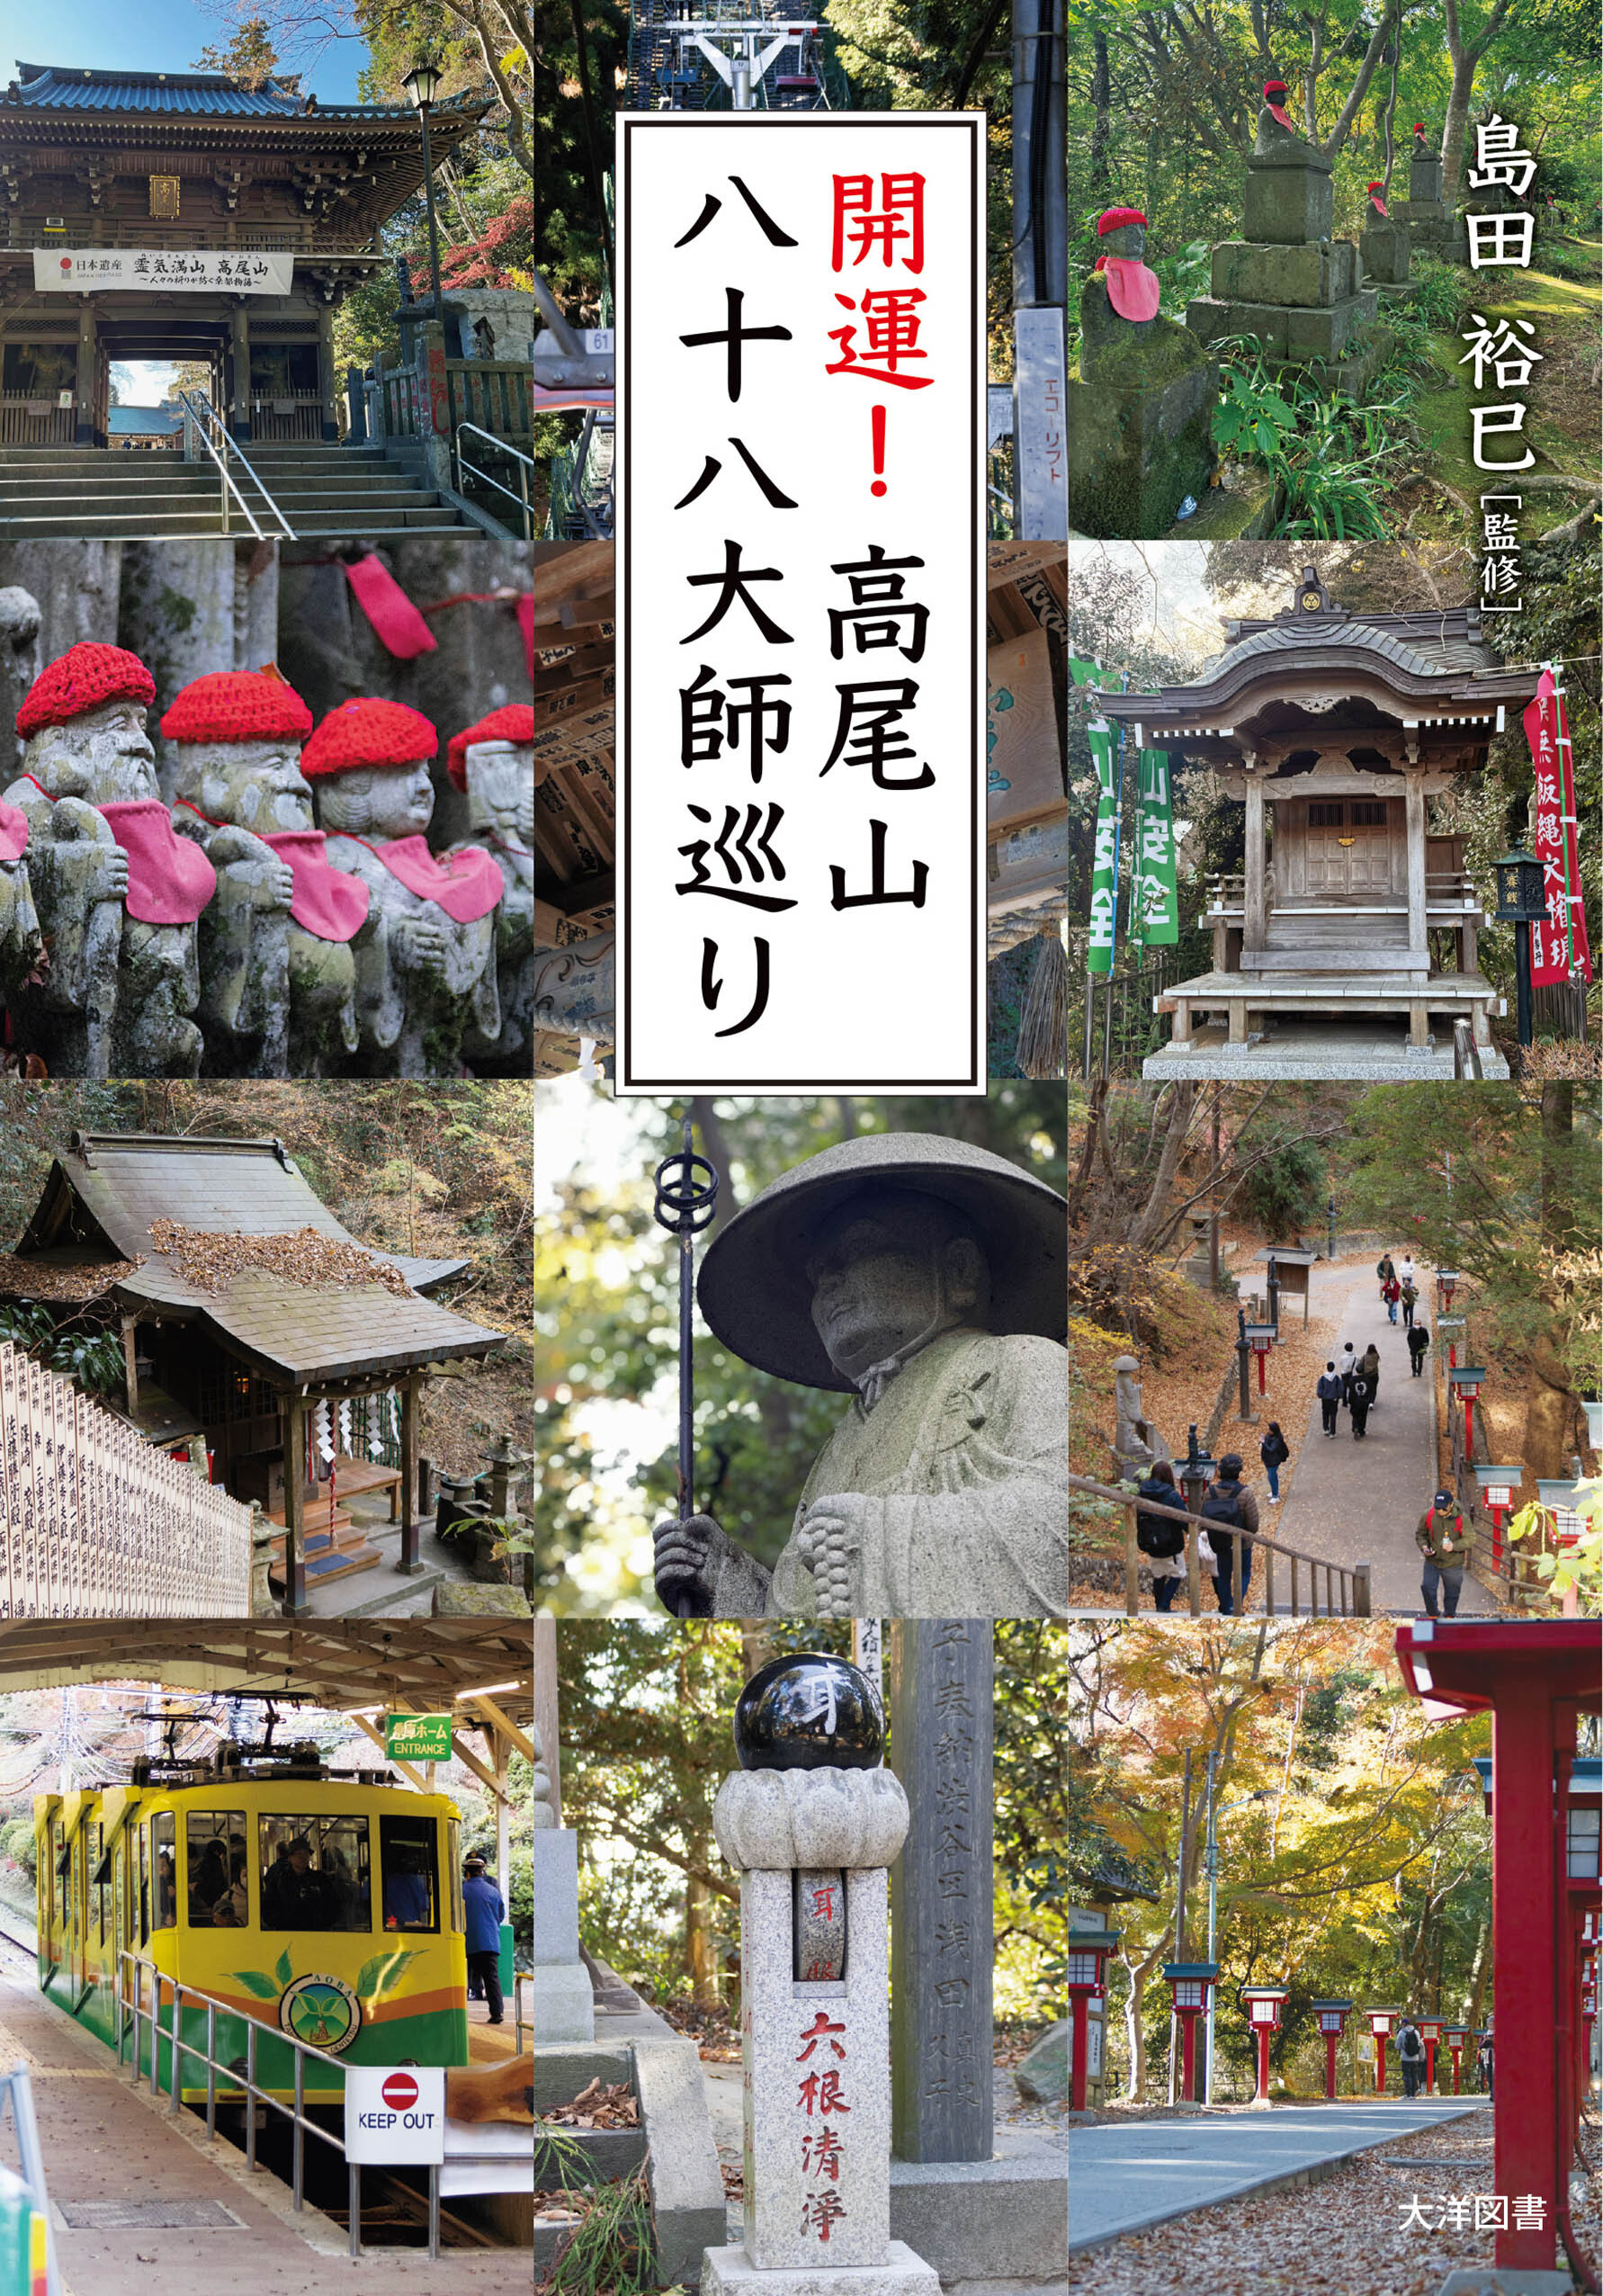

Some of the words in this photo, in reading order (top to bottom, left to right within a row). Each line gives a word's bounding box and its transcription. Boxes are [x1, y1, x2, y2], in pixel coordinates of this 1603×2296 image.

[76, 259, 123, 271] 日本遺産
[134, 257, 205, 274] 霊気満山
[217, 258, 270, 276] 高尾山
[594, 333, 608, 350] 61
[1044, 379, 1061, 483] エコーリフト
[800, 1662, 837, 1735] 耳
[394, 1742, 447, 1755] ENTRANCE
[812, 1888, 835, 1923] 耳
[313, 1973, 353, 1997] AOBA
[359, 2112, 397, 2130] KEEP
[403, 2112, 434, 2130] OUT
